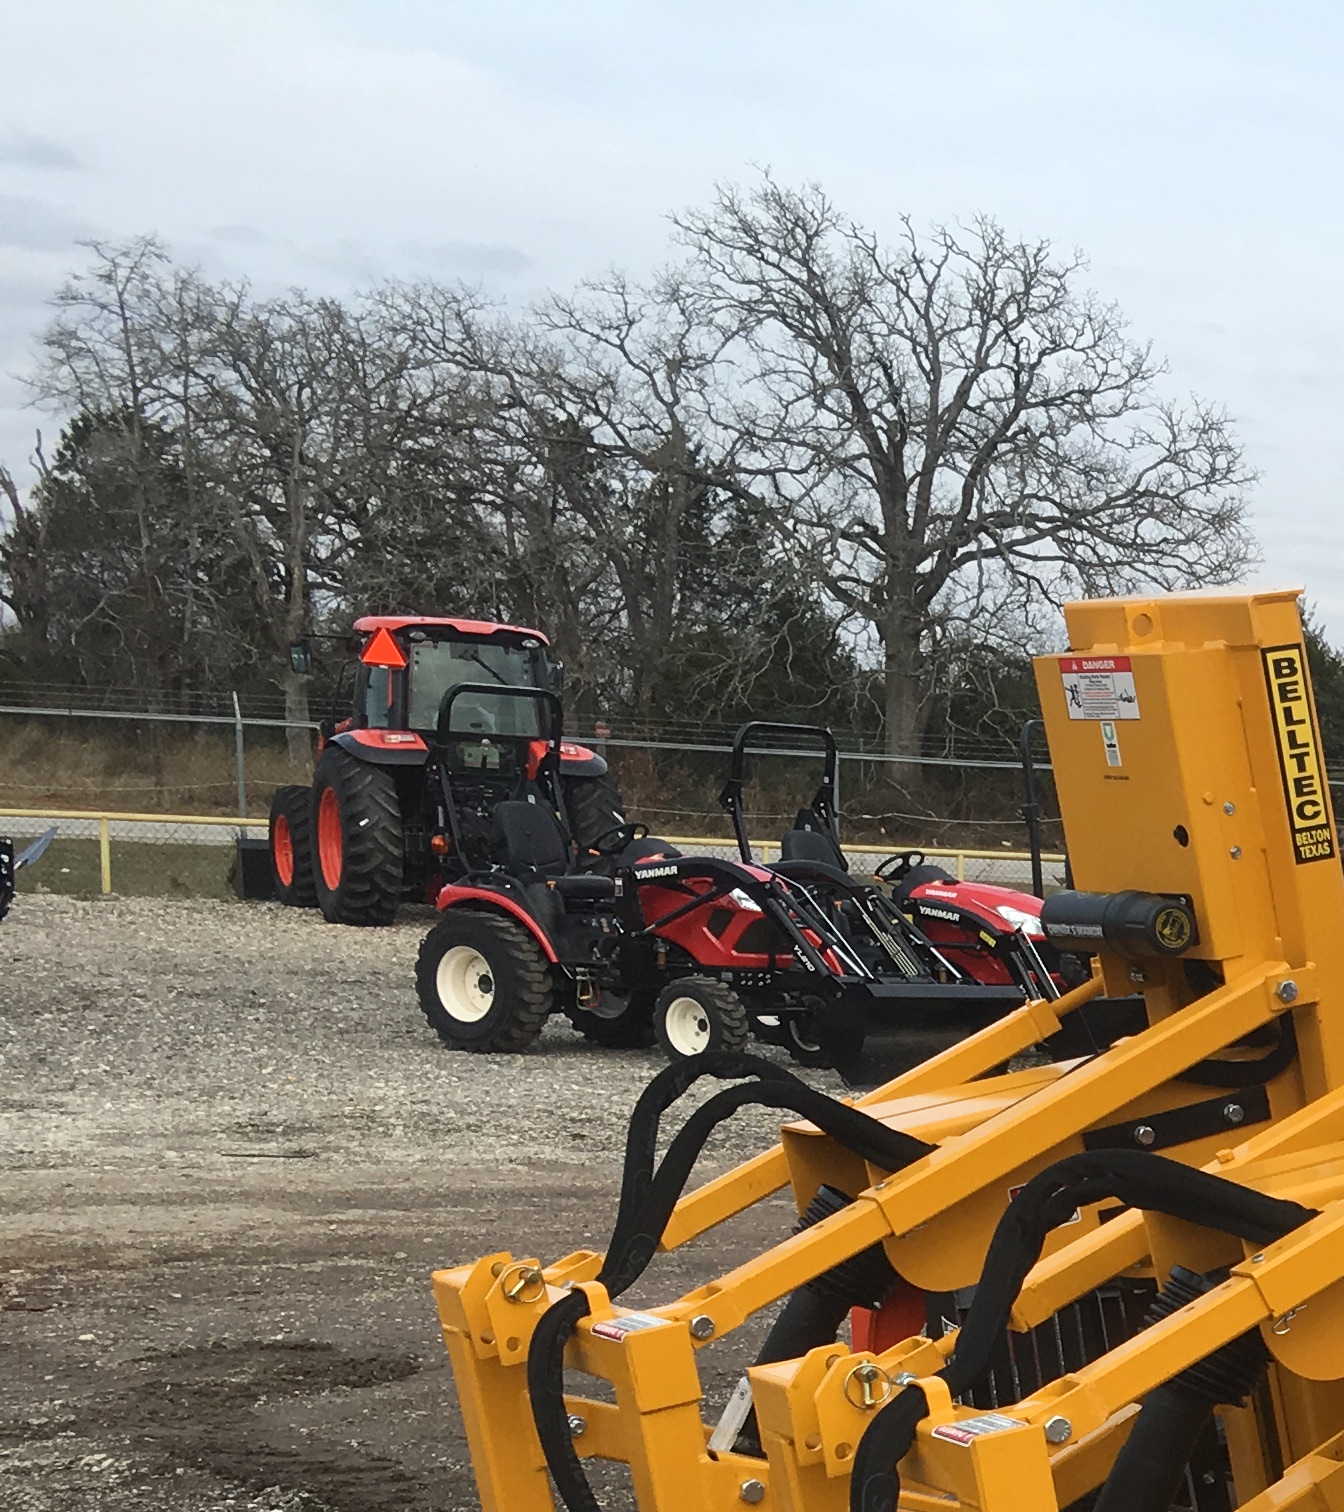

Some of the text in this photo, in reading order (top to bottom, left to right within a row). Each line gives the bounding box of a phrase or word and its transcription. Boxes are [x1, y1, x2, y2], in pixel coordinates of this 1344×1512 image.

[1082, 660, 1115, 669] DANGER
[1272, 656, 1322, 821] BELLTEC
[1296, 829, 1330, 845] BELTON
[1300, 843, 1330, 859] TEXAS
[635, 866, 677, 879] YANMAR
[925, 889, 957, 898] YANMAR
[919, 906, 960, 921] YANMAR
